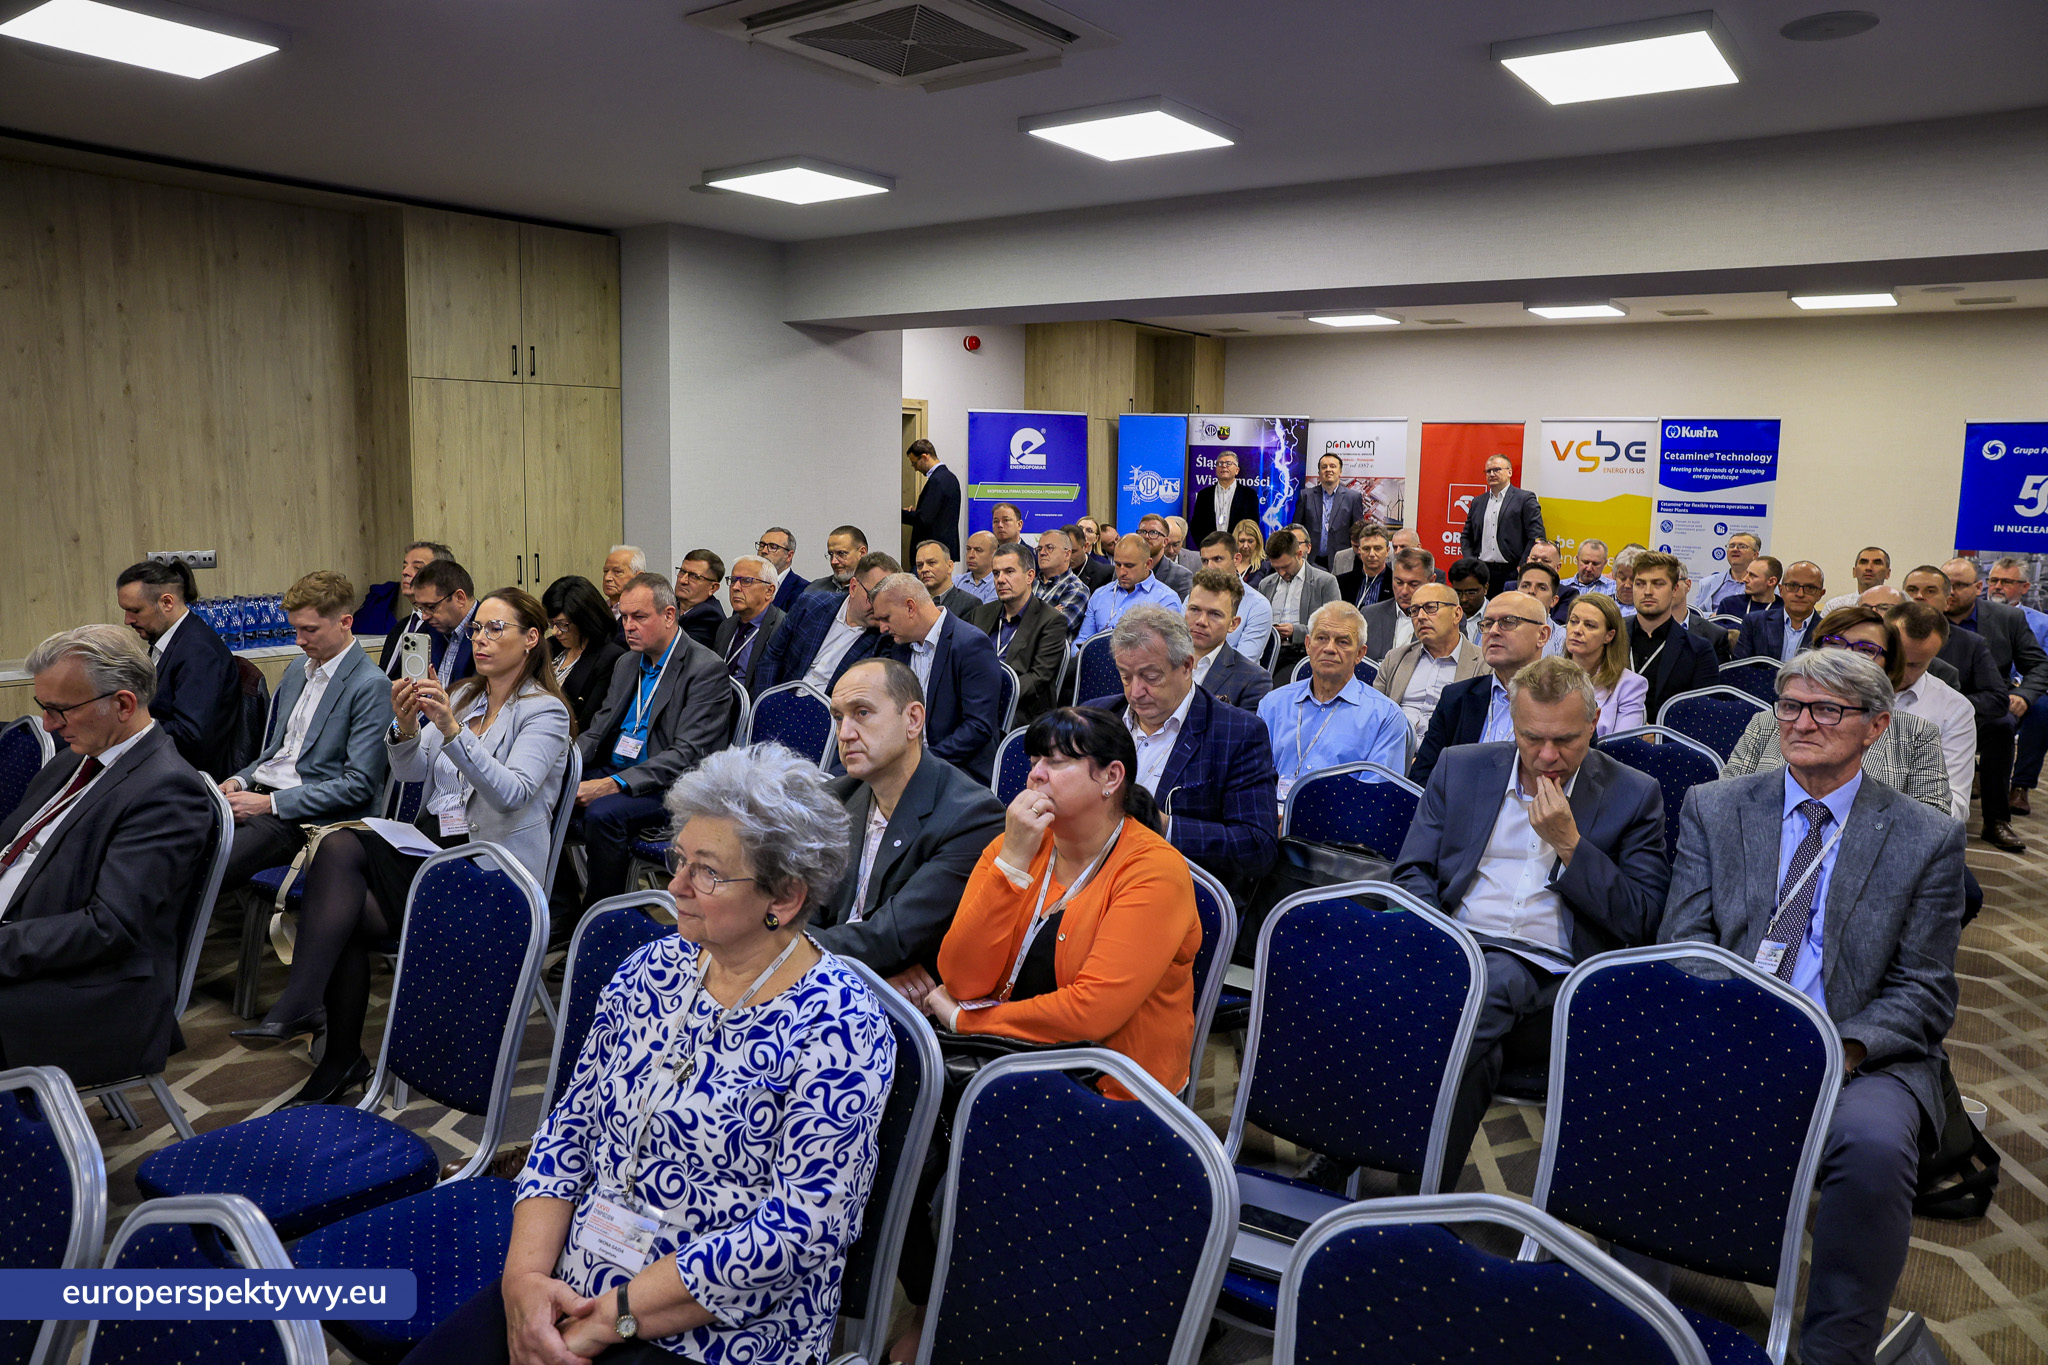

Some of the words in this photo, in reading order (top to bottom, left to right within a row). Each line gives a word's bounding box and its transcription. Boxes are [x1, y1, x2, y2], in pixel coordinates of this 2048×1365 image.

[1551, 430, 1646, 472] vgbe
[2013, 447, 2040, 456] Grupa
[1715, 452, 1773, 464] Technology
[1671, 466, 1692, 474] Meeting
[1728, 467, 1735, 475] of
[1141, 476, 1157, 494] SEP
[1993, 525, 2005, 533] IN
[1556, 534, 1575, 549] be
